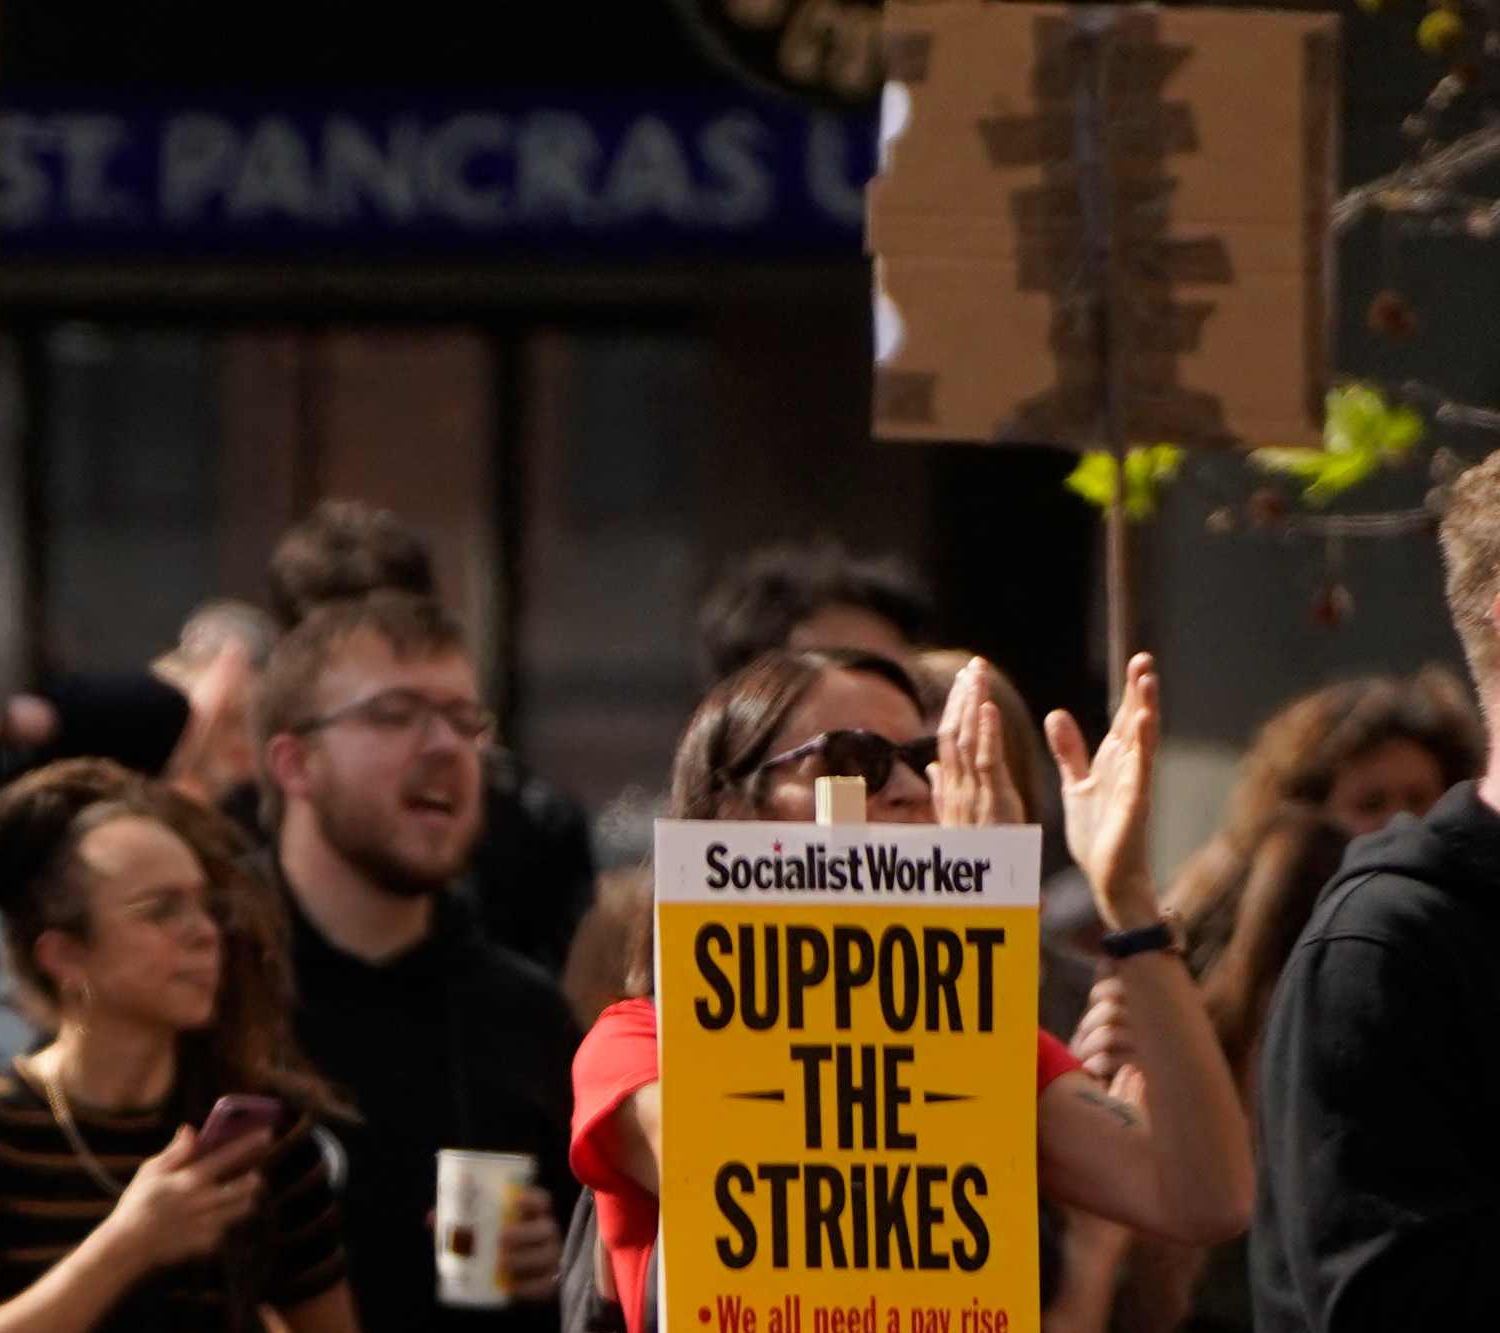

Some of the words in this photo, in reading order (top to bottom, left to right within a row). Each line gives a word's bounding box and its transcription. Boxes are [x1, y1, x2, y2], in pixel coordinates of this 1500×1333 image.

[158, 110, 772, 226] PANCRAS
[705, 841, 863, 891] Socialist
[865, 844, 991, 893] Worker
[693, 921, 1005, 1032] SUPPORT
[790, 1042, 917, 1151] THE
[714, 1161, 991, 1272] STRIKES
